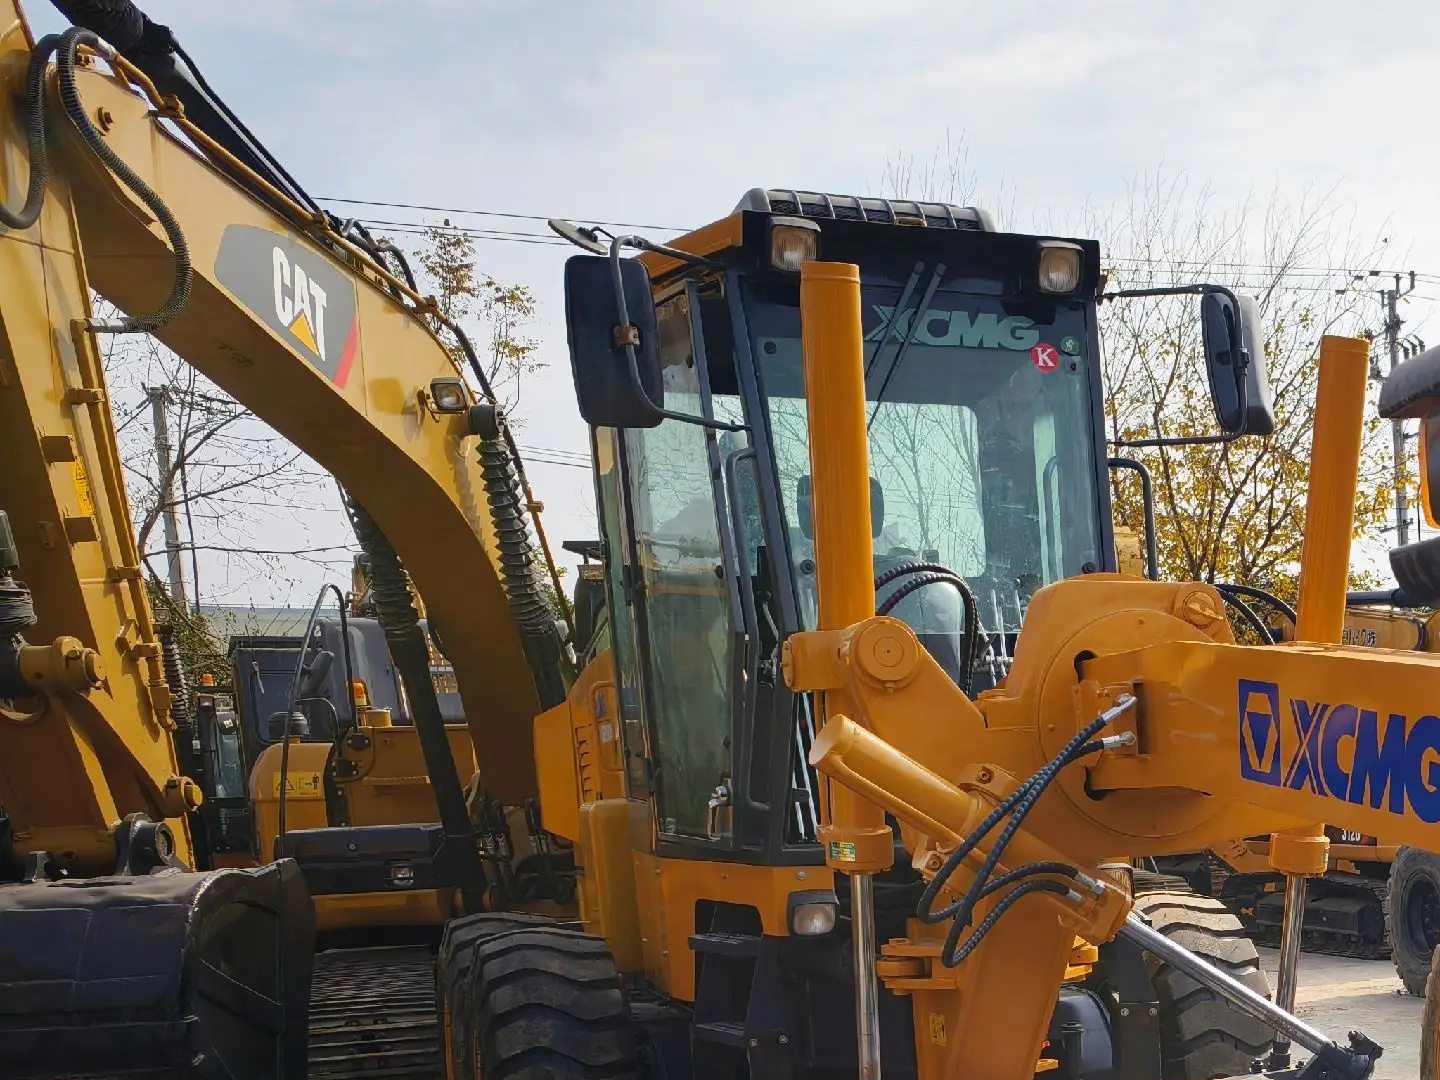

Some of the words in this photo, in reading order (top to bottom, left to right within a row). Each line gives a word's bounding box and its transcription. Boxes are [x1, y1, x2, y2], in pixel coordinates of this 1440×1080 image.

[272, 246, 328, 362] CAT
[864, 304, 1040, 352] XCMG
[1034, 347, 1055, 368] K
